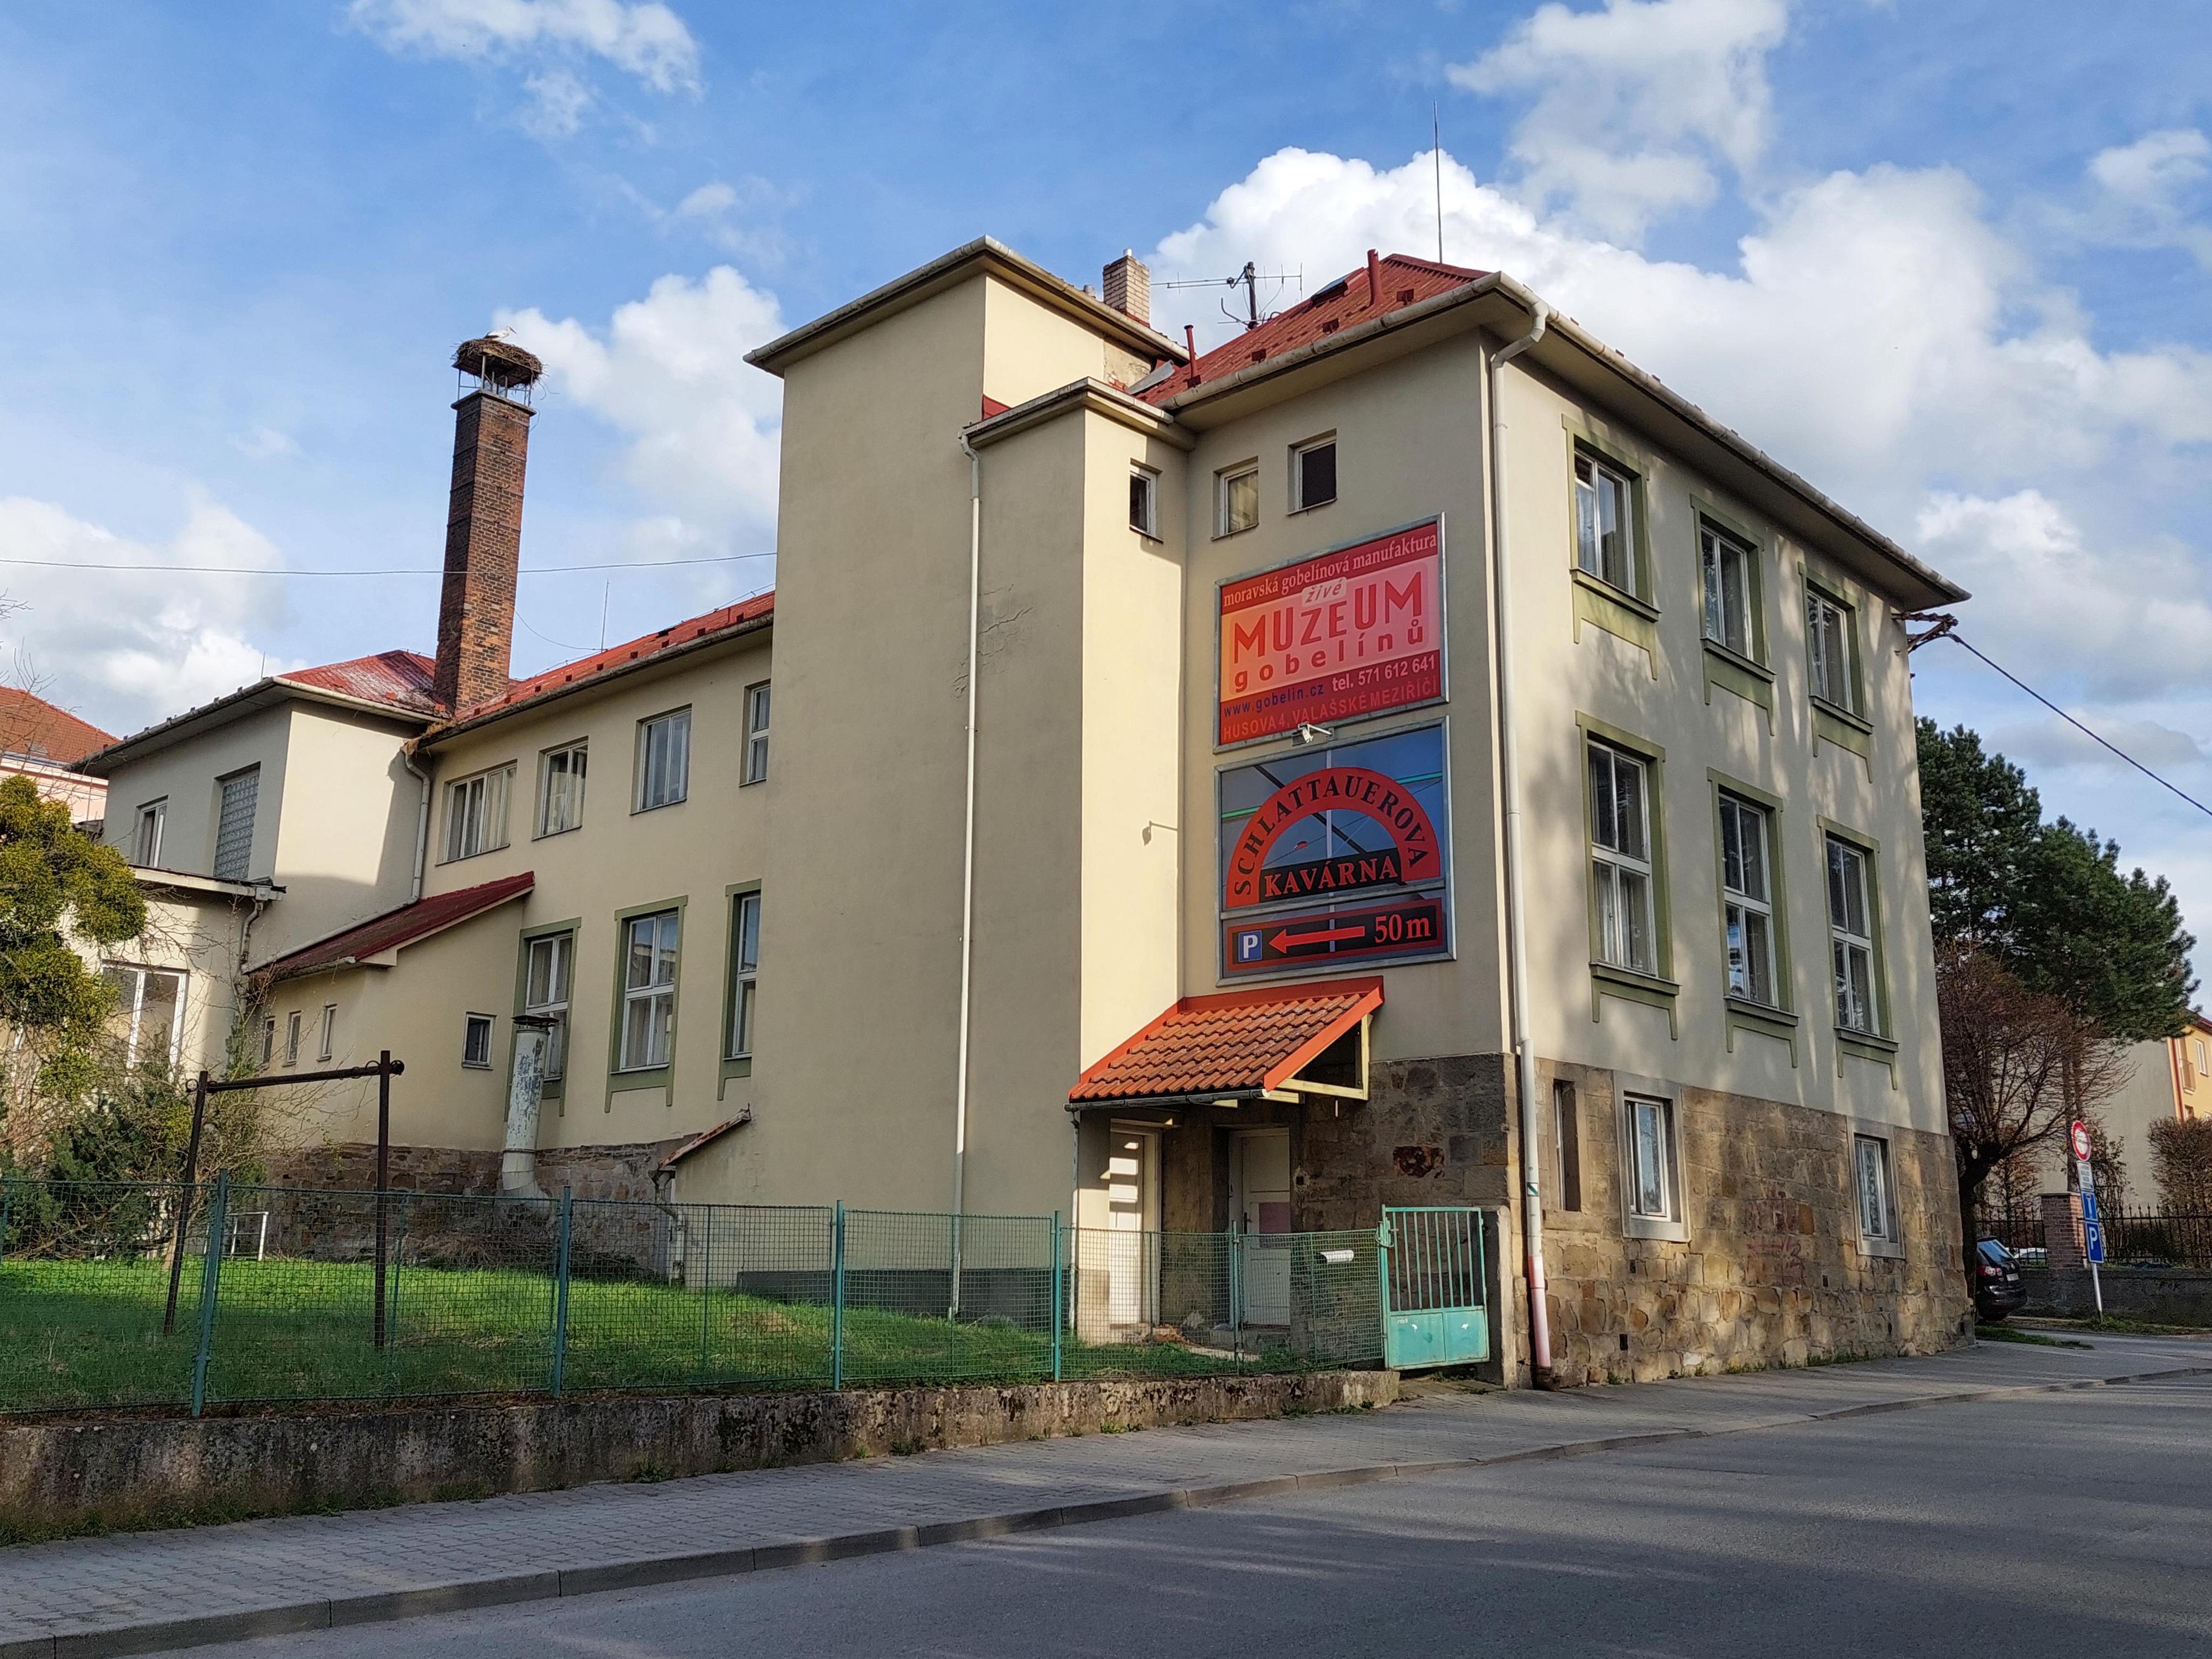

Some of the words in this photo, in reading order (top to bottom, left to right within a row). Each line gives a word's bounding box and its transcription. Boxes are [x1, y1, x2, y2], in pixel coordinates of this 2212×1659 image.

[1223, 576, 1279, 607] moravská
[1281, 555, 1349, 595] gobelínová
[1353, 534, 1437, 570] manufaktura
[1306, 578, 1342, 603] živé
[1234, 571, 1422, 664] MUZEUM
[1224, 684, 1324, 717] www.gobelin.cz
[1332, 674, 1354, 692] tel.
[1358, 666, 1380, 686] 571
[1384, 660, 1407, 680] 612
[1412, 654, 1436, 674] 641
[1235, 618, 1423, 692] gobelínů
[1223, 716, 1276, 740] HUSOVA
[1279, 713, 1290, 728] 4,
[1292, 692, 1366, 724] VALAŠSKÉ
[1370, 675, 1437, 707] MEZIŘÍČÍ
[1235, 775, 1428, 895] SCHLATTAUEROVA
[1264, 855, 1398, 897] KAVÁRNA
[1243, 935, 1258, 959] P
[1374, 914, 1402, 943] 50
[1405, 916, 1431, 938] m
[2089, 1226, 2098, 1250] P
